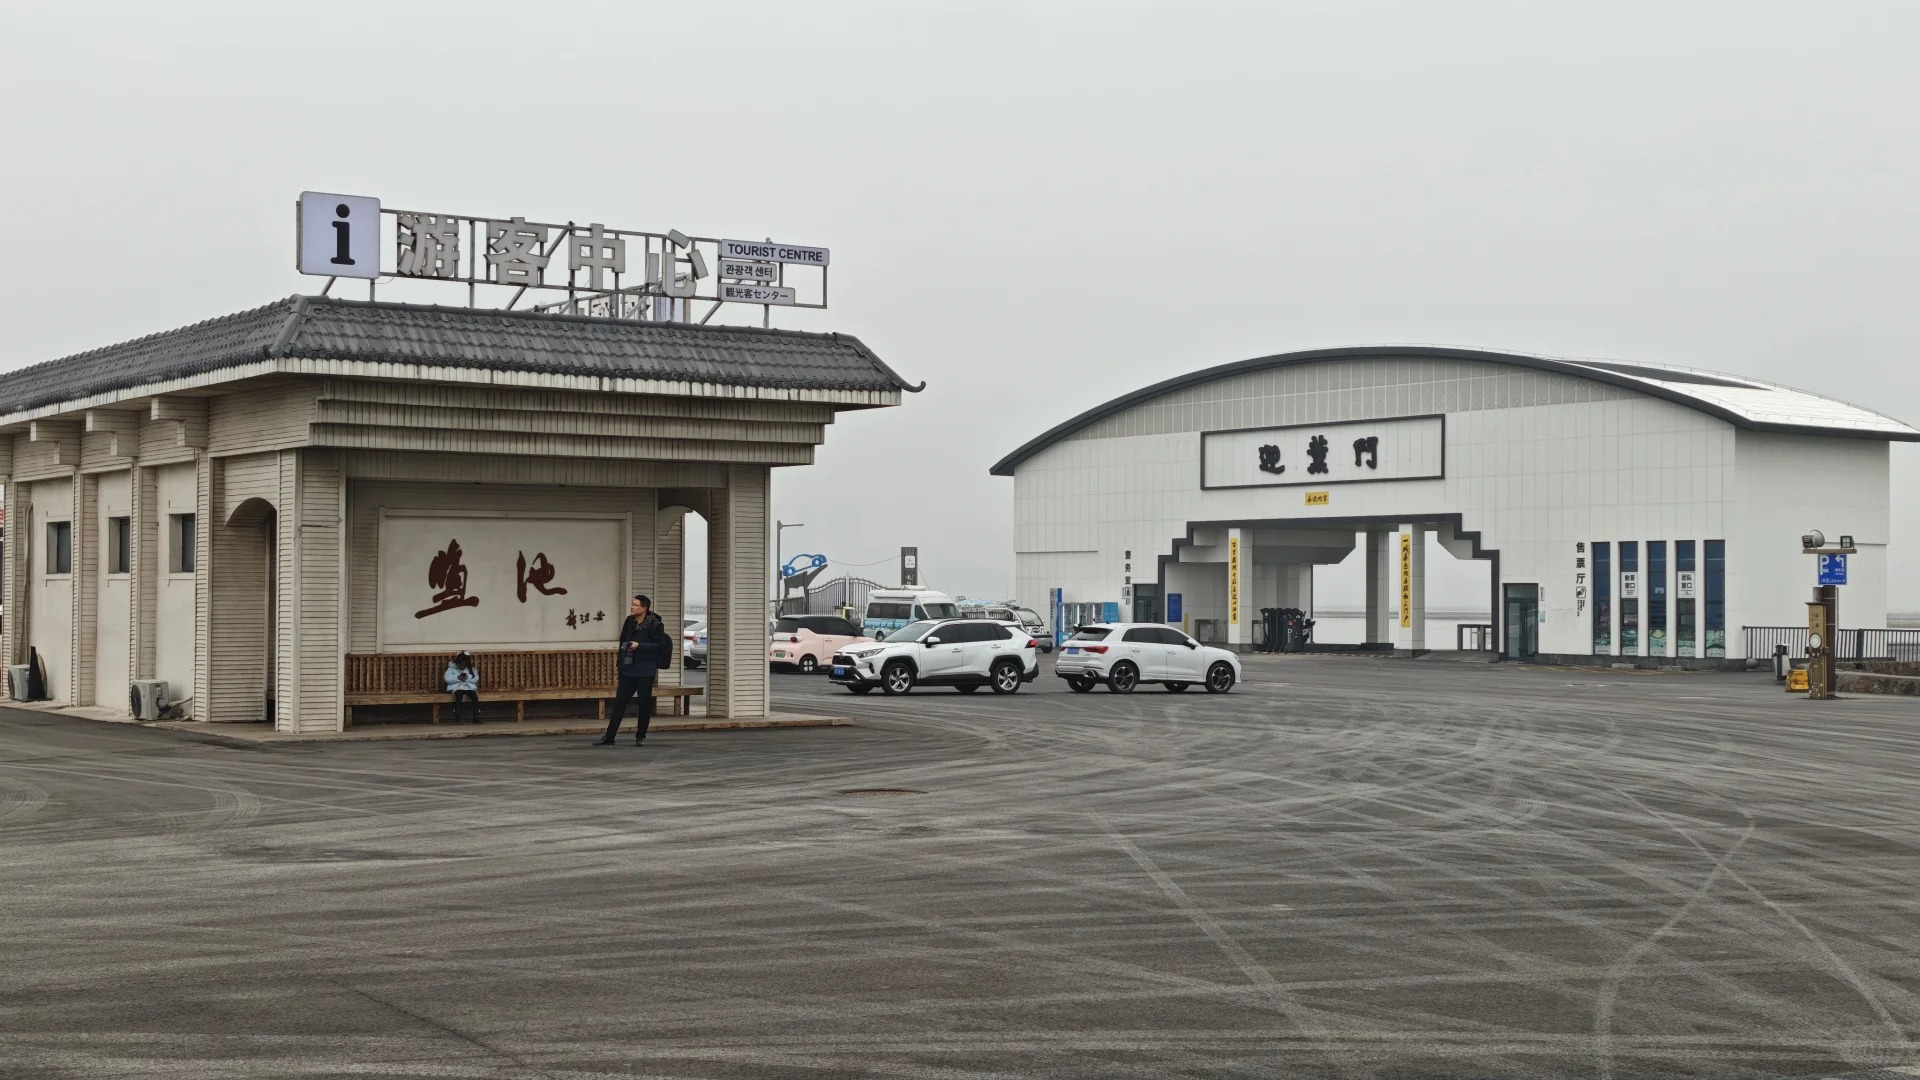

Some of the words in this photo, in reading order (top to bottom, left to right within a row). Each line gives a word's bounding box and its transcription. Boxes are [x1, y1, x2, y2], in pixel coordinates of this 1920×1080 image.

[330, 203, 355, 265] i
[397, 213, 709, 297] 游客中心
[728, 243, 776, 258] TOURIST
[778, 248, 823, 262] CENTRE
[725, 264, 753, 277] 관광객
[755, 265, 773, 278] 센터
[725, 286, 788, 300] 観光客センター
[1124, 550, 1132, 585] 警务室
[1576, 541, 1586, 584] 售票厅
